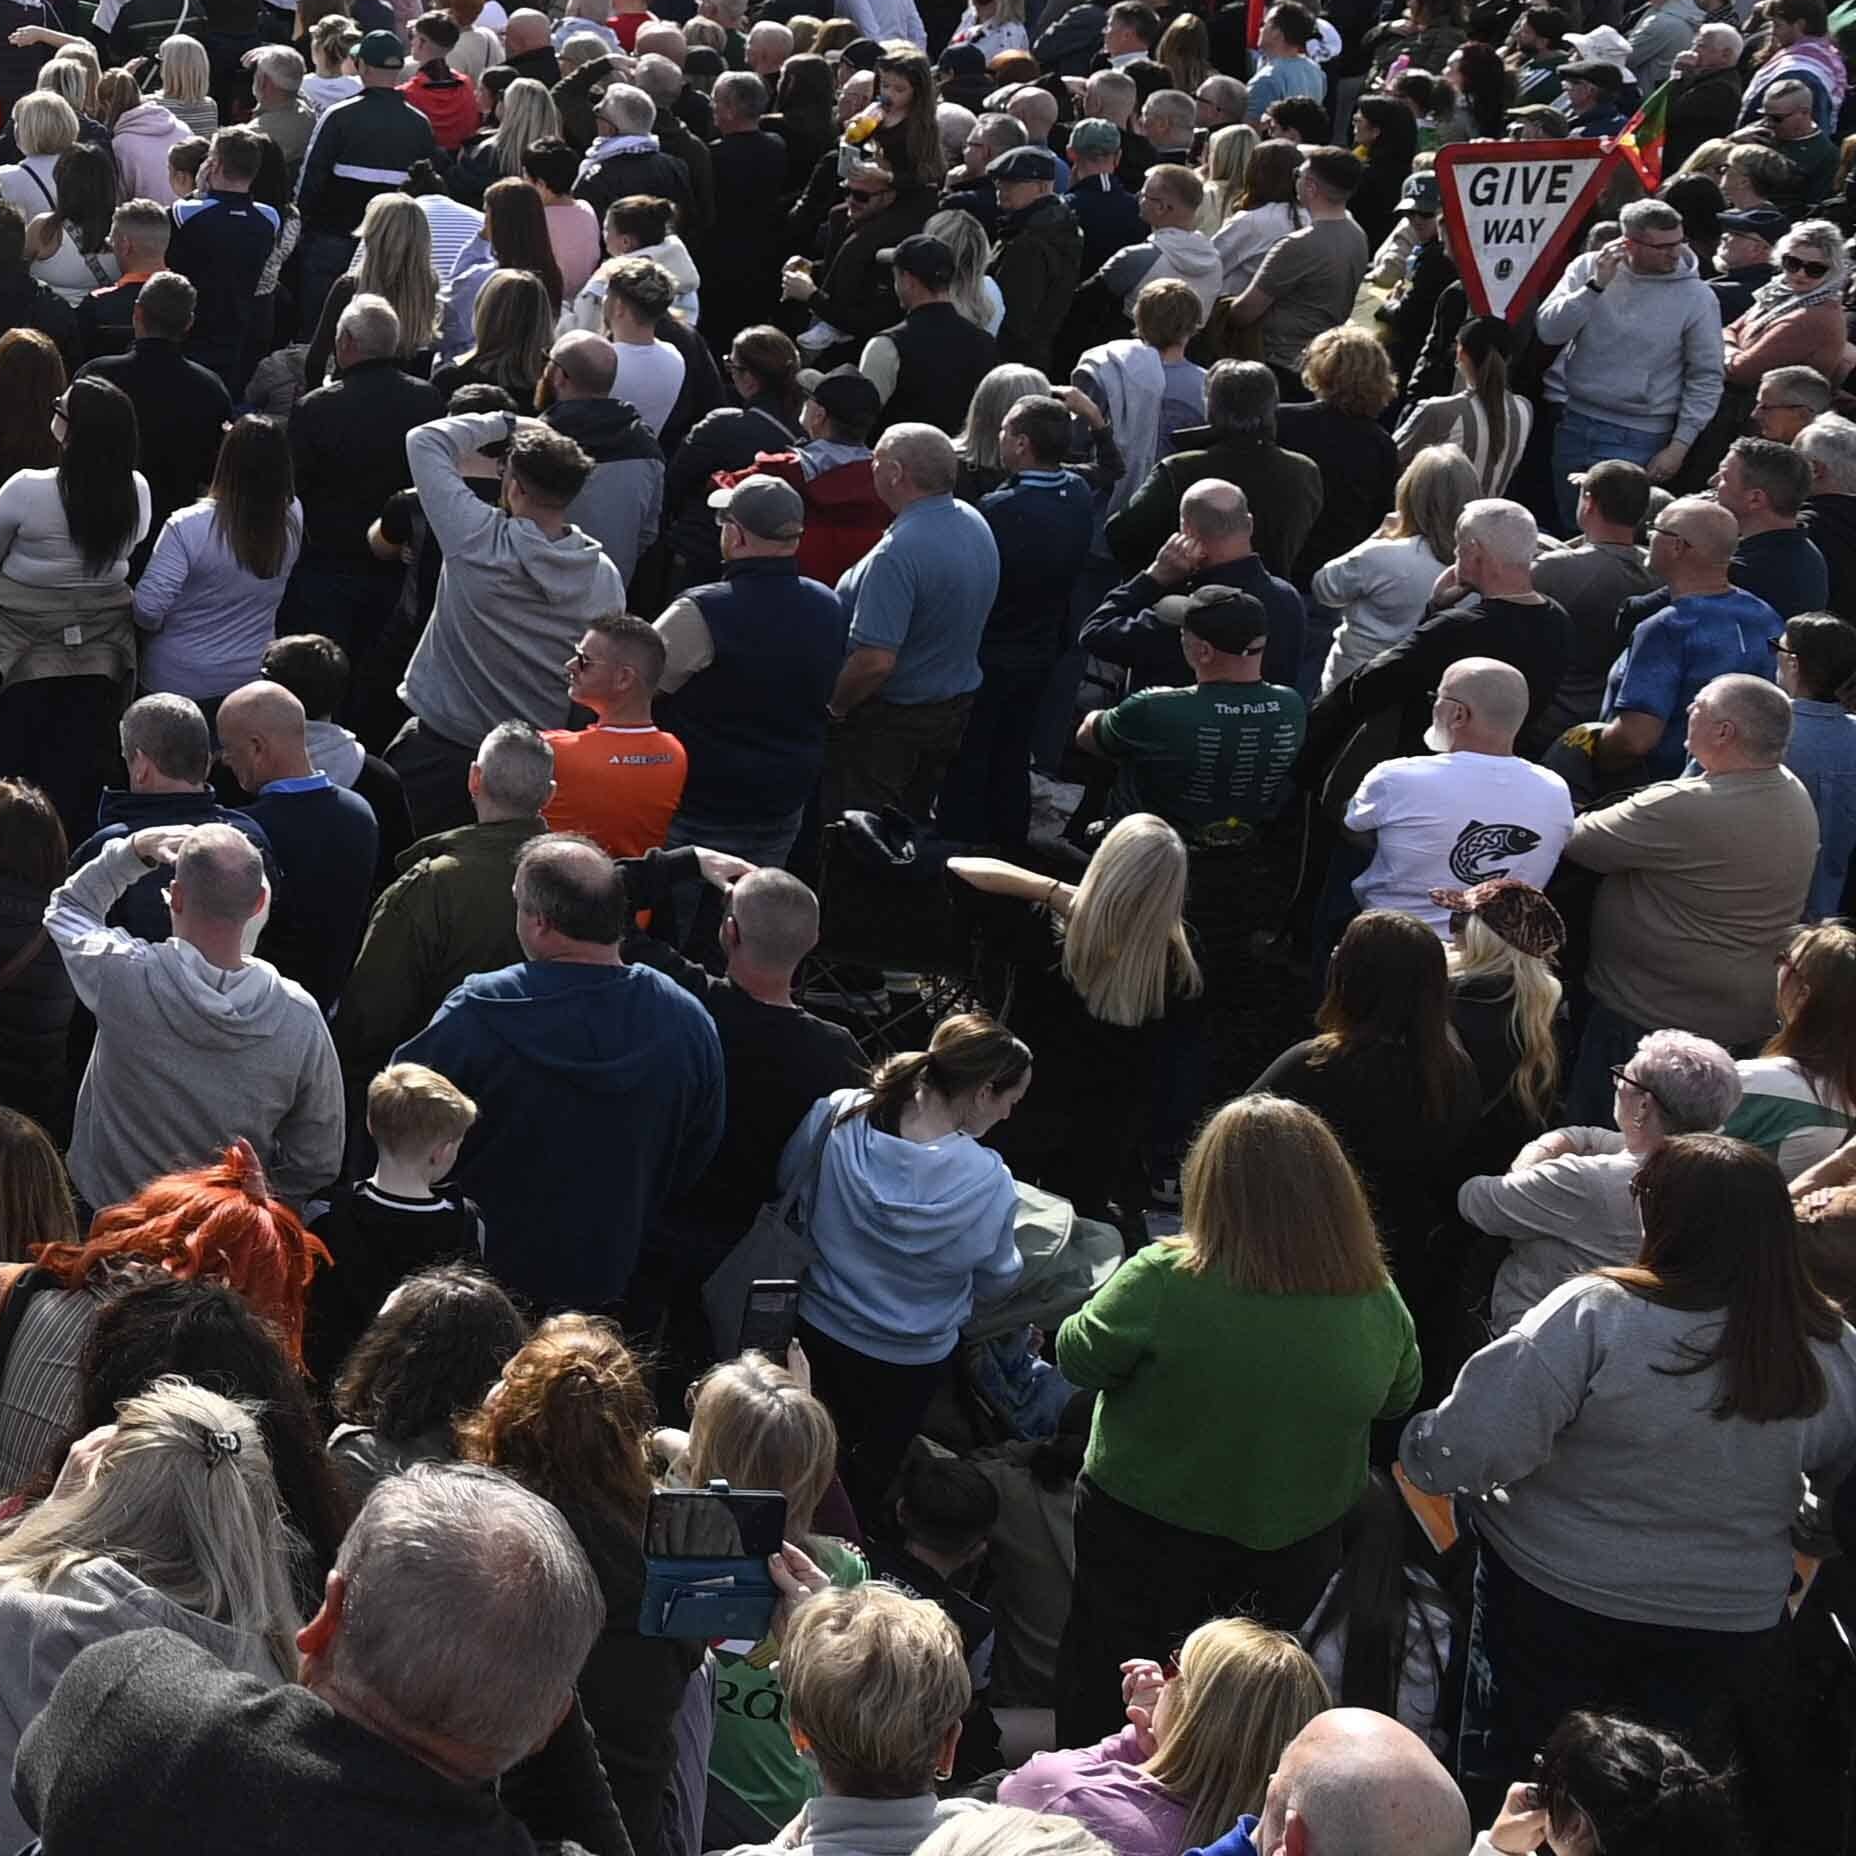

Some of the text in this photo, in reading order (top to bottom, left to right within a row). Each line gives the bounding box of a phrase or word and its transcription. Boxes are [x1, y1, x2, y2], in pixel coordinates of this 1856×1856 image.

[1469, 164, 1573, 207] GIVE
[1483, 217, 1545, 245] WAY
[1214, 700, 1281, 715] The Full 32
